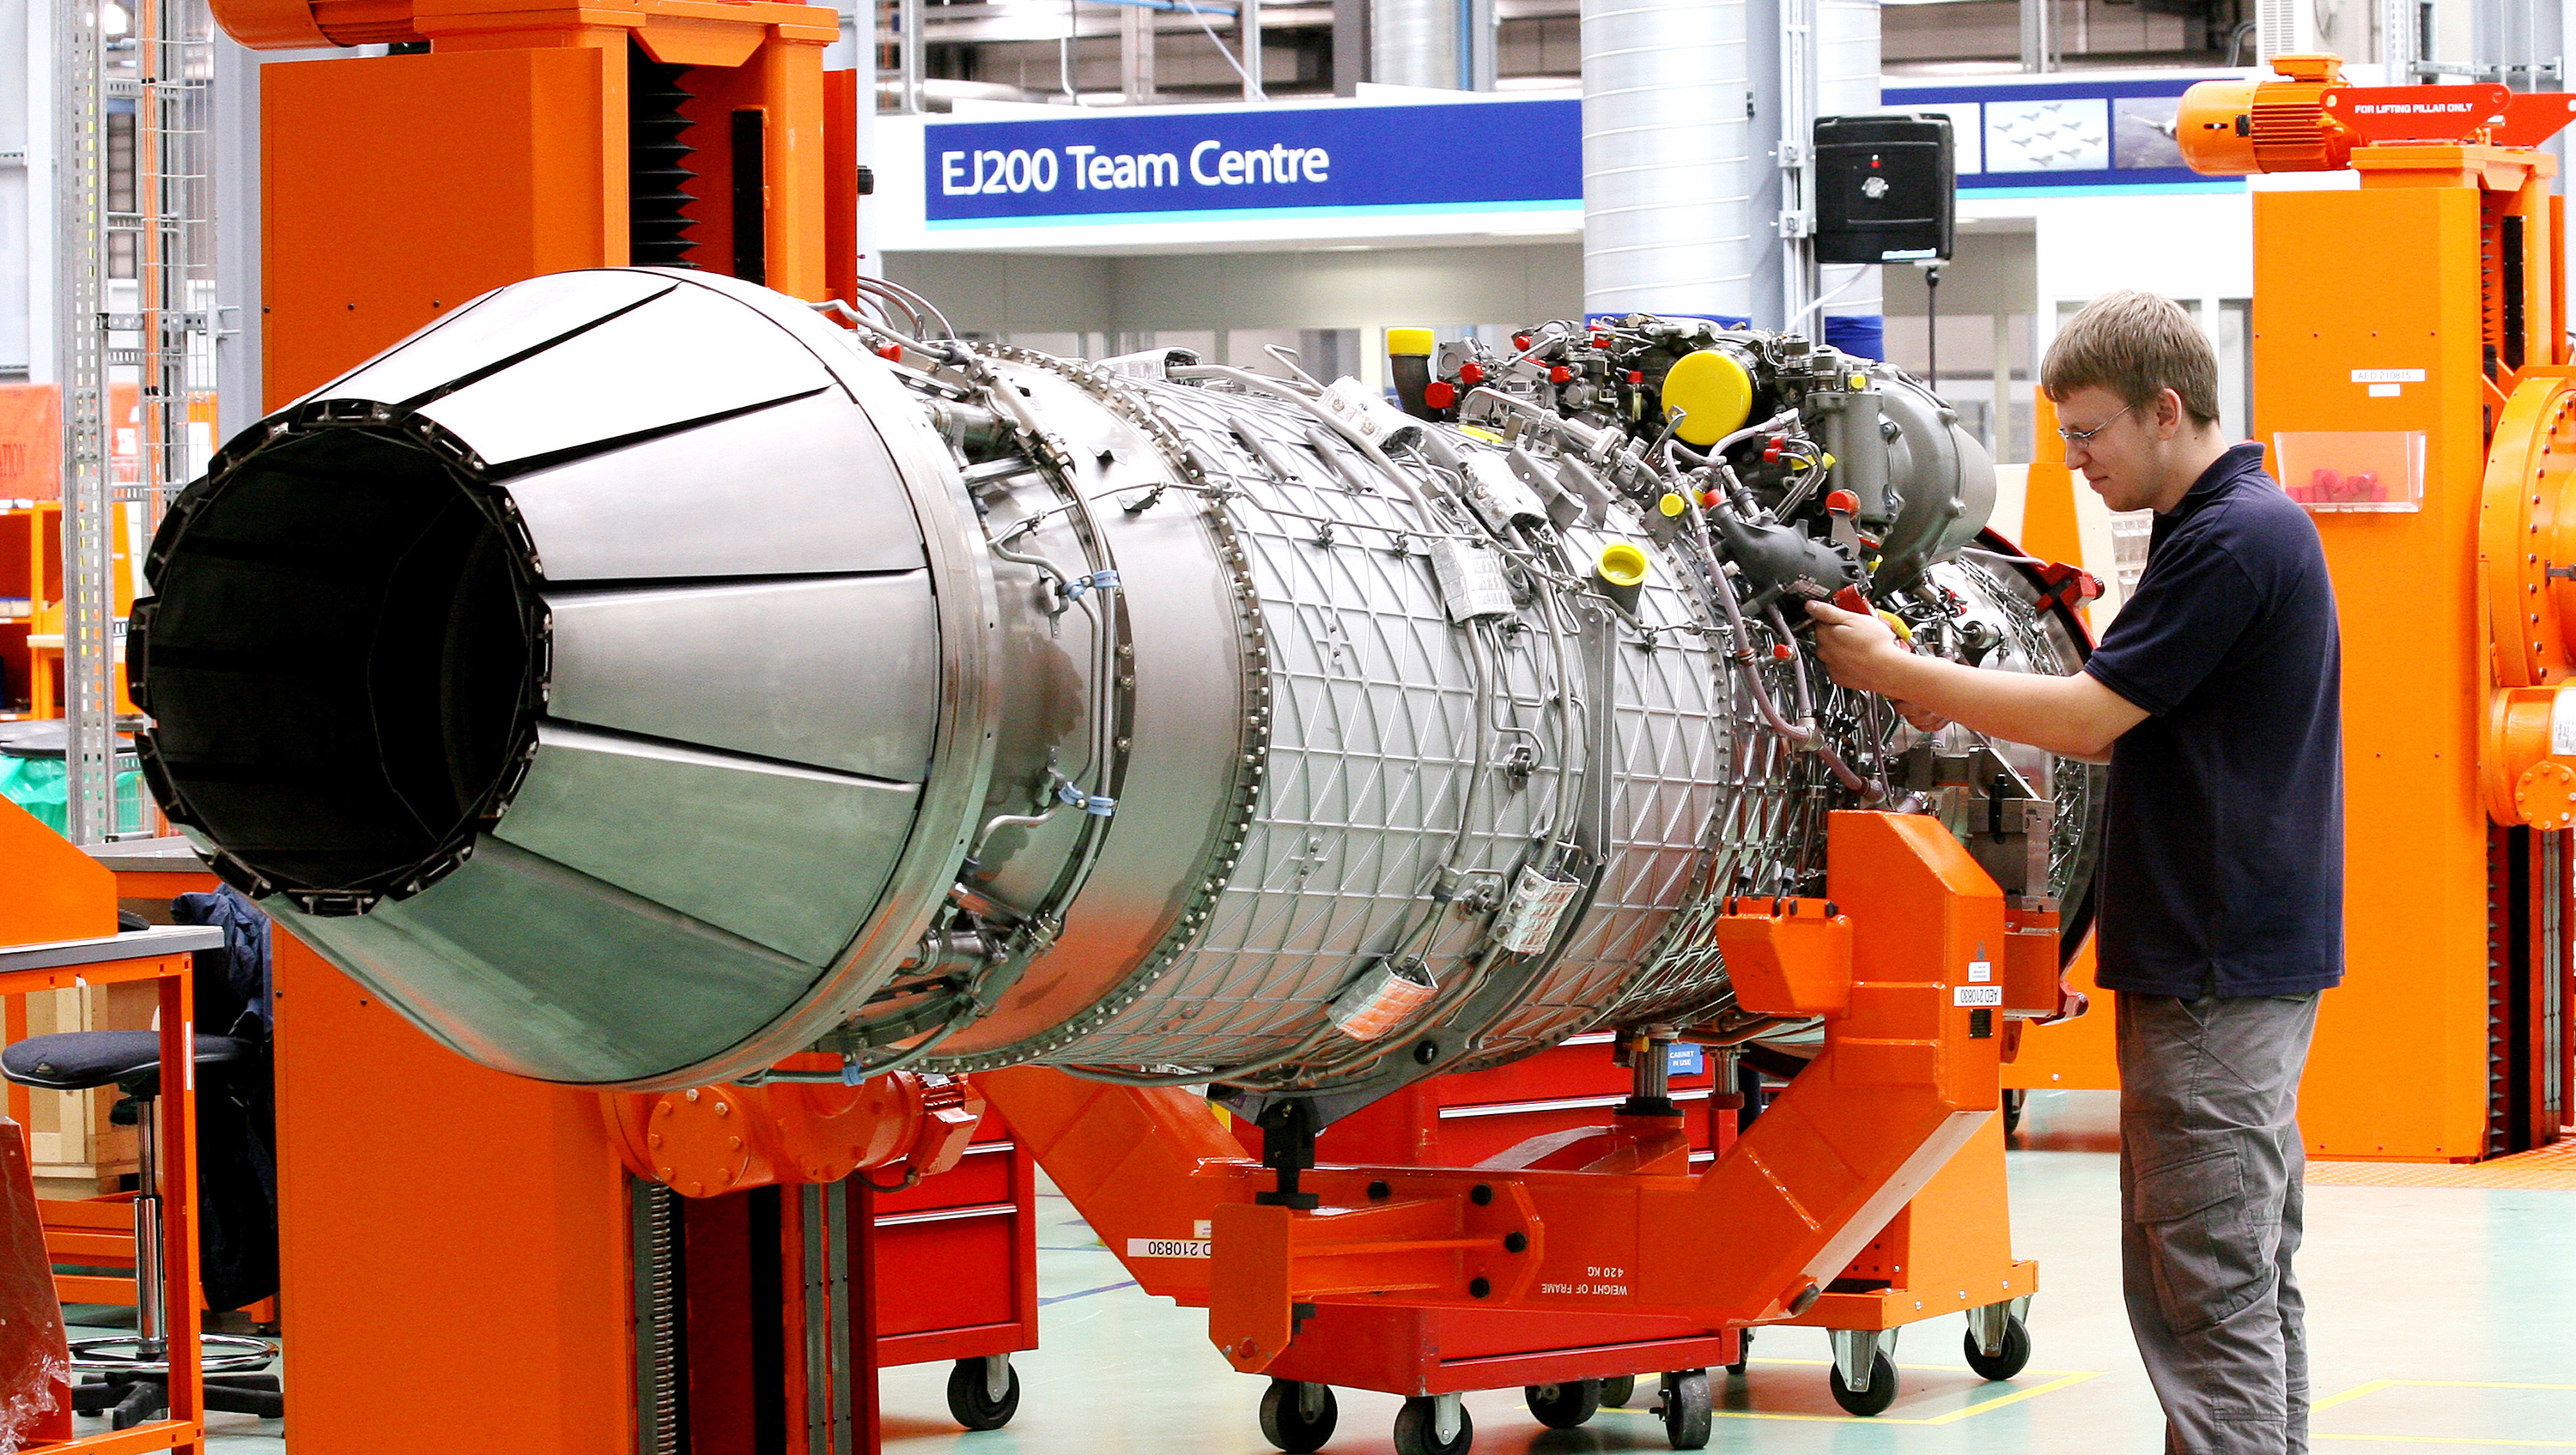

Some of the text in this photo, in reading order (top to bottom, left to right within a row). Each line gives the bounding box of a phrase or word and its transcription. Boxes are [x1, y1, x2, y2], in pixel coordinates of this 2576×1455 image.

[2354, 102, 2473, 114] FOR LIFTING PILLAR ONLY
[942, 139, 1330, 196] EJ200 Team Centre
[1984, 989, 1999, 1003] AED
[1148, 1241, 1198, 1256] 210830
[1587, 1266, 1624, 1278] 420 KG
[1541, 1283, 1628, 1295] WEIGHT OF FRAME
